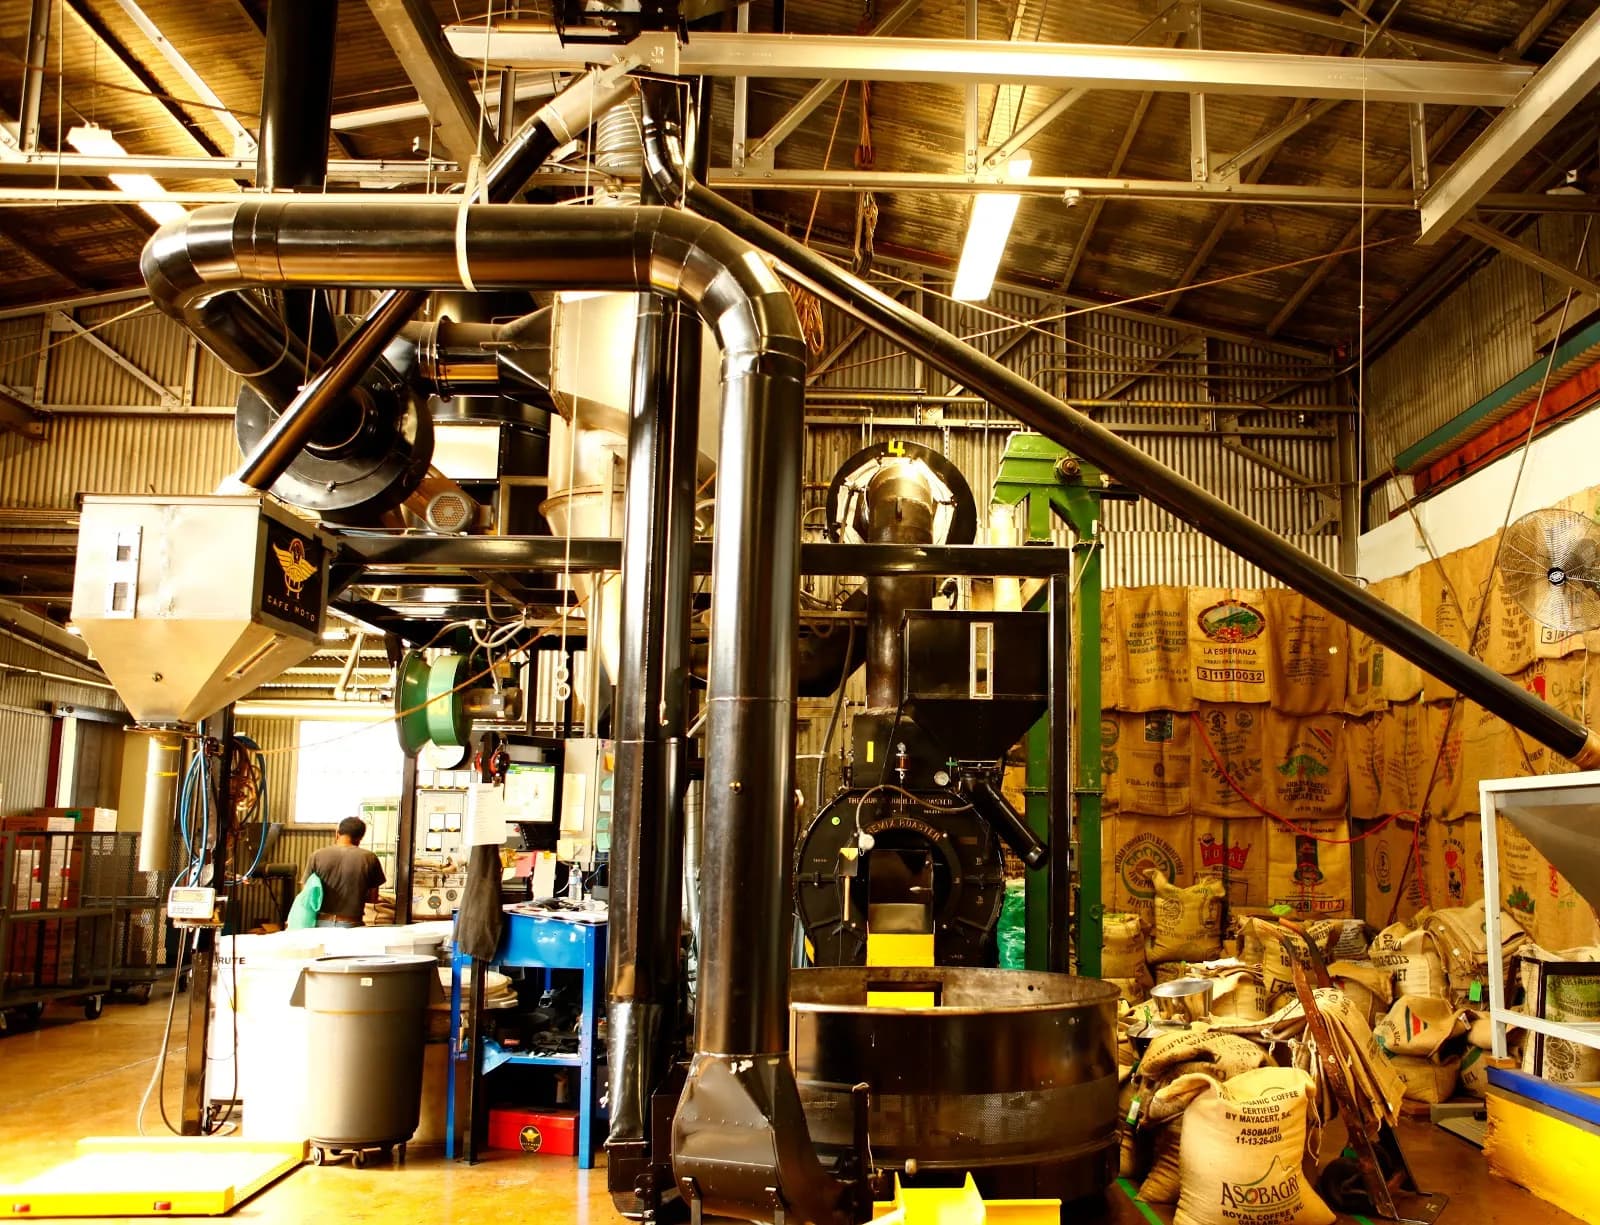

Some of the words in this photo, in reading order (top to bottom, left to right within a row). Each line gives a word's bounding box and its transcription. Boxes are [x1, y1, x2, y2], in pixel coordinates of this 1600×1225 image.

[888, 437, 905, 456] 4
[294, 606, 315, 622] MOTO
[1546, 630, 1553, 641] 3
[1203, 647, 1213, 655] LA
[1214, 647, 1257, 656] ESPERANZA
[1201, 670, 1208, 679] 3
[1213, 671, 1231, 680] 119
[1235, 671, 1262, 681] 0032
[218, 956, 246, 965] RUTE
[1271, 1090, 1300, 1102] COFFEE
[1242, 1104, 1280, 1115] CERTIFIED
[1225, 1111, 1237, 1121] BY
[1240, 1126, 1280, 1137] ASOBAGRI
[1221, 1174, 1300, 1209] ASOBAGRI
[1222, 1209, 1253, 1221] ROYAL
[1256, 1208, 1291, 1220] COFFEE
